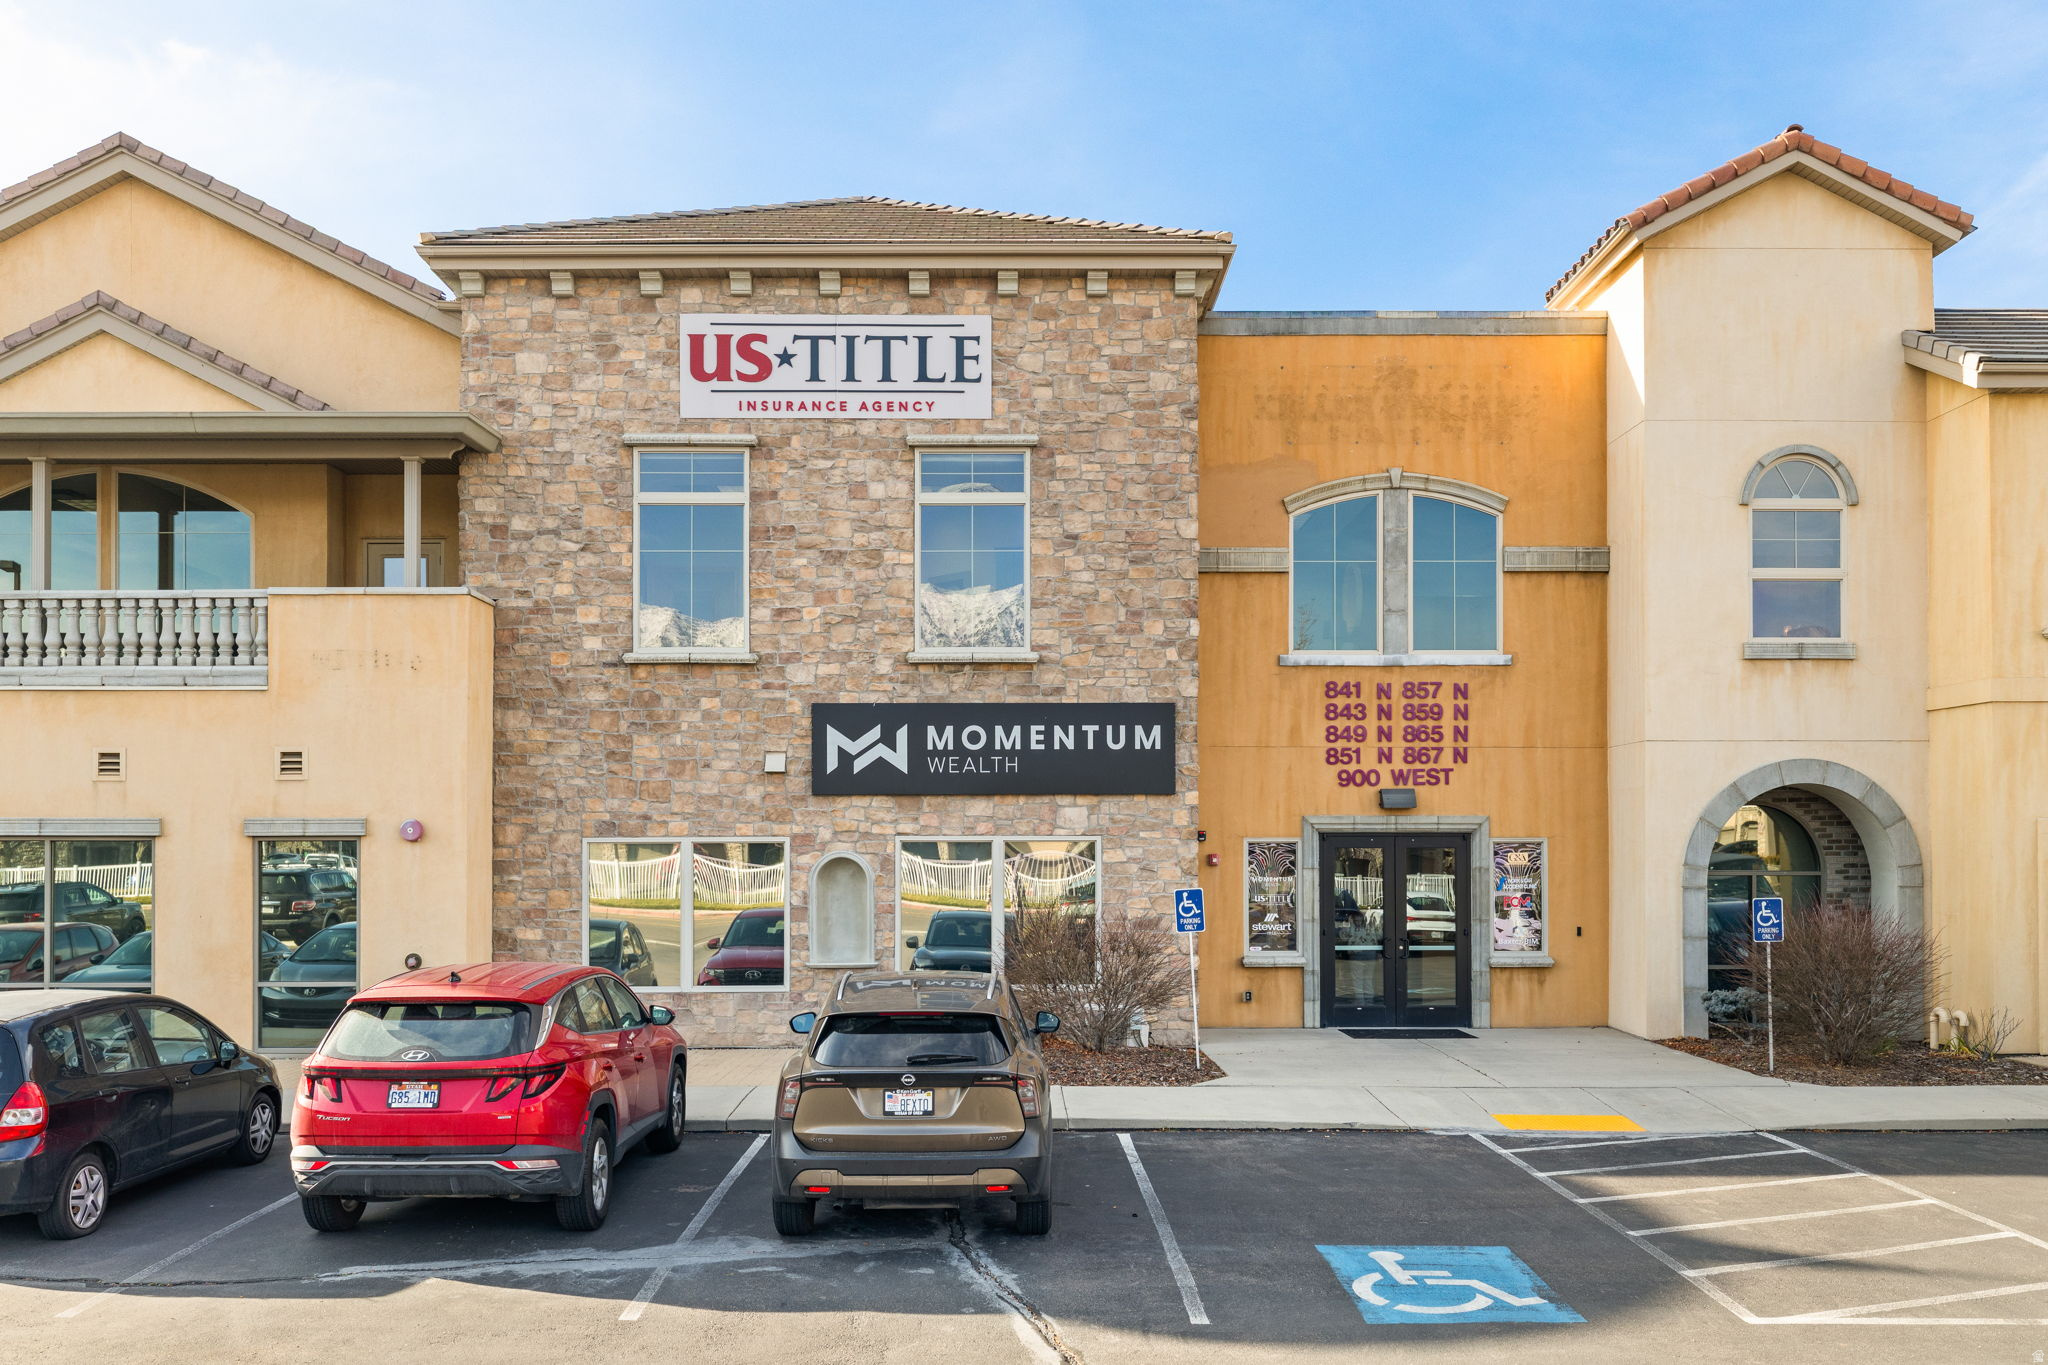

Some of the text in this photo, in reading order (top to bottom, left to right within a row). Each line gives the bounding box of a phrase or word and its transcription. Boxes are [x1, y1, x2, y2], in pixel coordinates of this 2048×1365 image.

[687, 332, 983, 383] US TITLE
[738, 400, 936, 412] INSURANCE AGENCY
[1324, 681, 1469, 700] 841 N 857 N
[1324, 703, 1469, 721] 843 N 859 N
[927, 725, 1161, 750] MOMENTUM
[1325, 724, 1469, 743] 849 N 865 N
[927, 756, 1019, 773] WEALTH
[1325, 746, 1468, 765] 851 N 867 N
[1337, 768, 1454, 787] 900 WEST
[390, 1091, 410, 1104] G85
